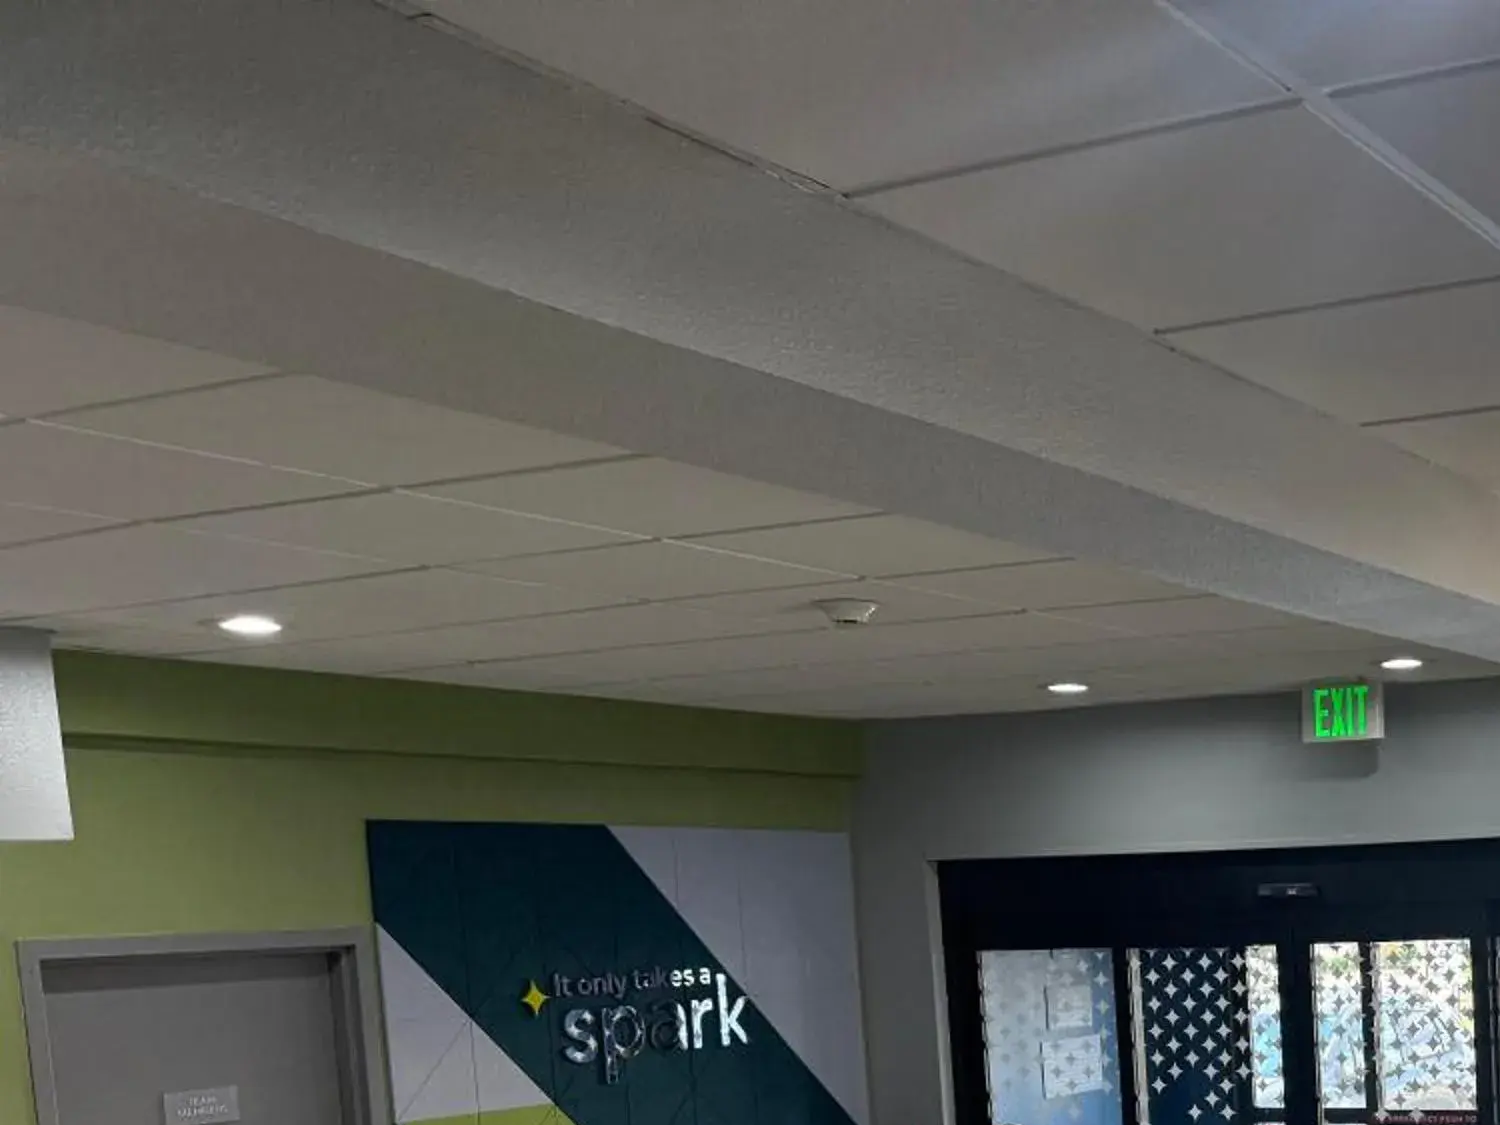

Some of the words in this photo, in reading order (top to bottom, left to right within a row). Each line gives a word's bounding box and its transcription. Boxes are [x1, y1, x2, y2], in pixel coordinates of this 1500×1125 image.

[1313, 685, 1369, 738] EXIT
[553, 972, 573, 996] It
[577, 974, 627, 998] only
[633, 966, 695, 989] takes
[699, 967, 711, 986] a
[564, 972, 750, 1085] spark
